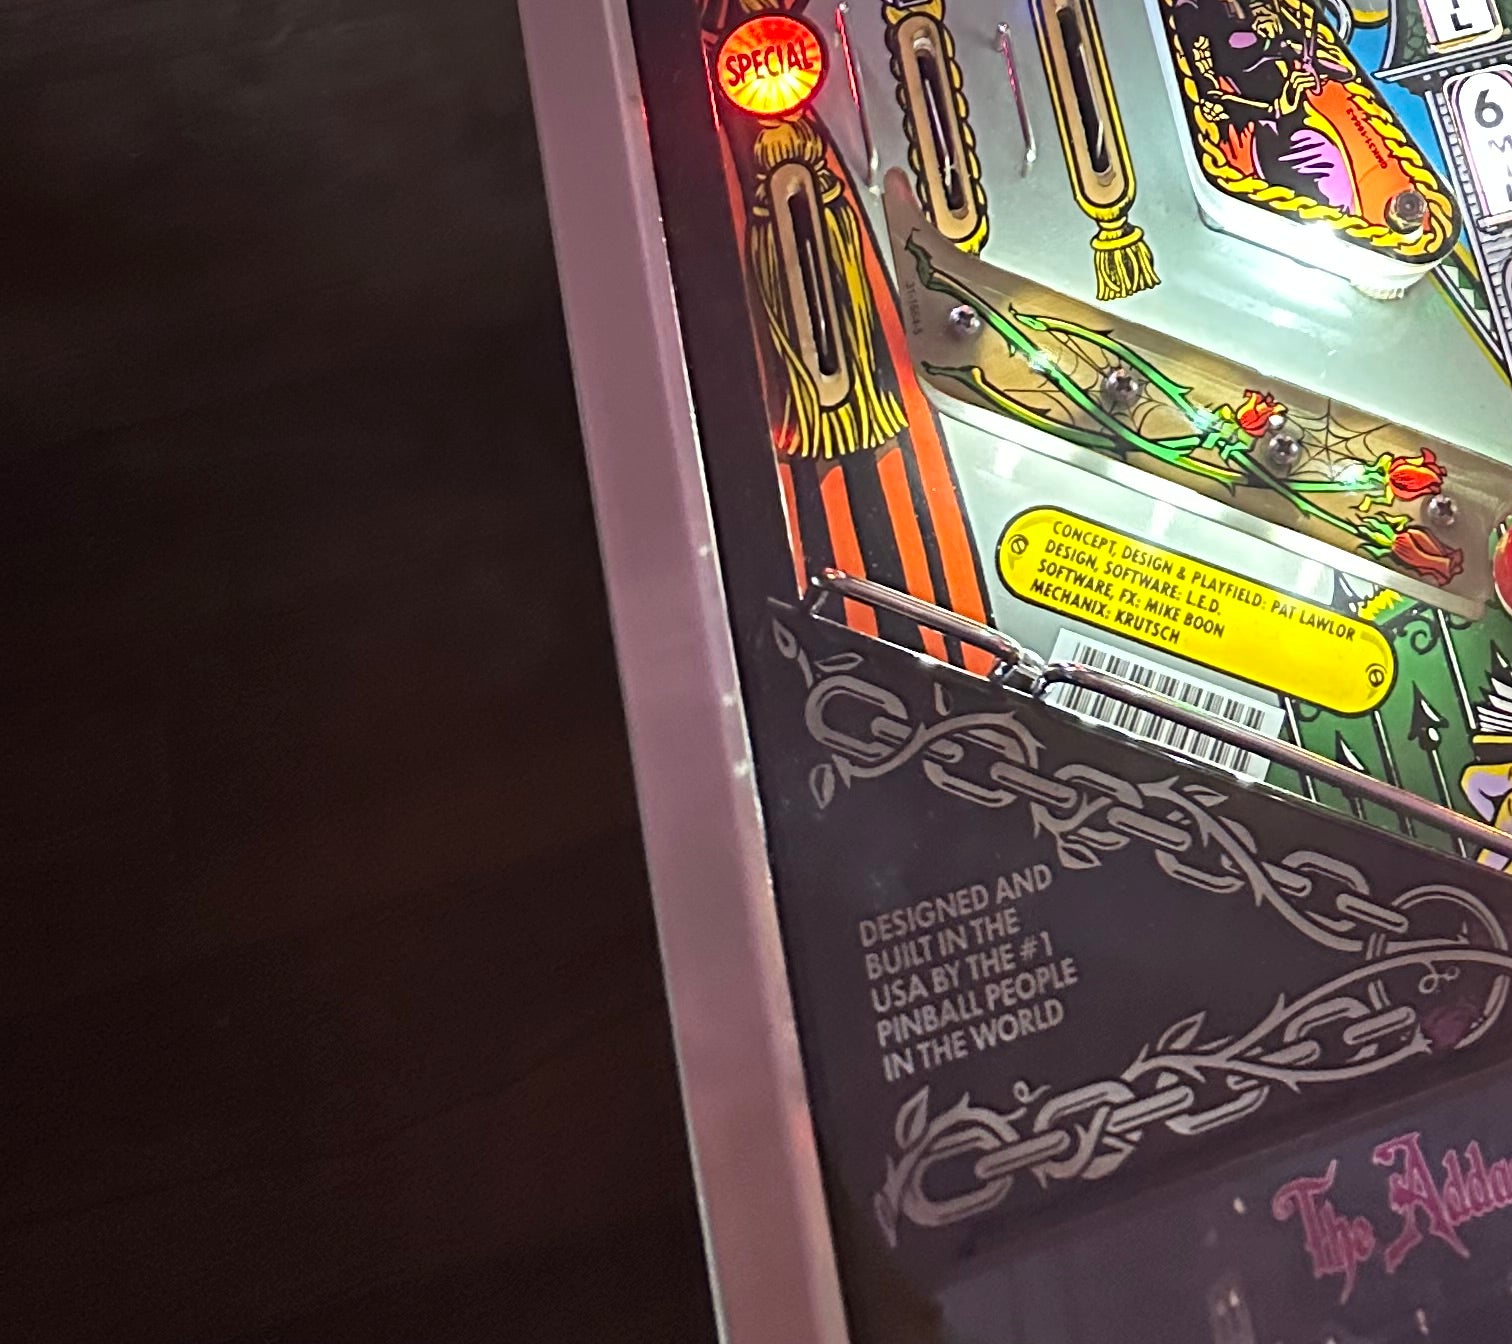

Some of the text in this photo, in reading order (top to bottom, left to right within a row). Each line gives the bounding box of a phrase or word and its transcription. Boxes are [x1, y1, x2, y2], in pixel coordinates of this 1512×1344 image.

[726, 41, 814, 87] SPECIAL
[1474, 89, 1504, 129] 6
[1028, 577, 1182, 645] MECHANIX: KRUTSCH
[1036, 558, 1226, 639] SOFTWARE, FX: MIKE BOON
[1043, 538, 1224, 615] DESIGN, SOFTWARE: L.E.D.
[1050, 518, 1357, 642] CONCEPT, DESIGN & PLAYFIELD: PAT LAWLOR
[859, 863, 1052, 948] DESIGNED AND
[865, 908, 1021, 980] BUILT IN THE
[871, 931, 1053, 1013] USA BY THE #1
[876, 958, 1079, 1048] PINBALL PEOPLE
[882, 999, 1064, 1082] IN THE WORLD
[1272, 1159, 1375, 1306] The
